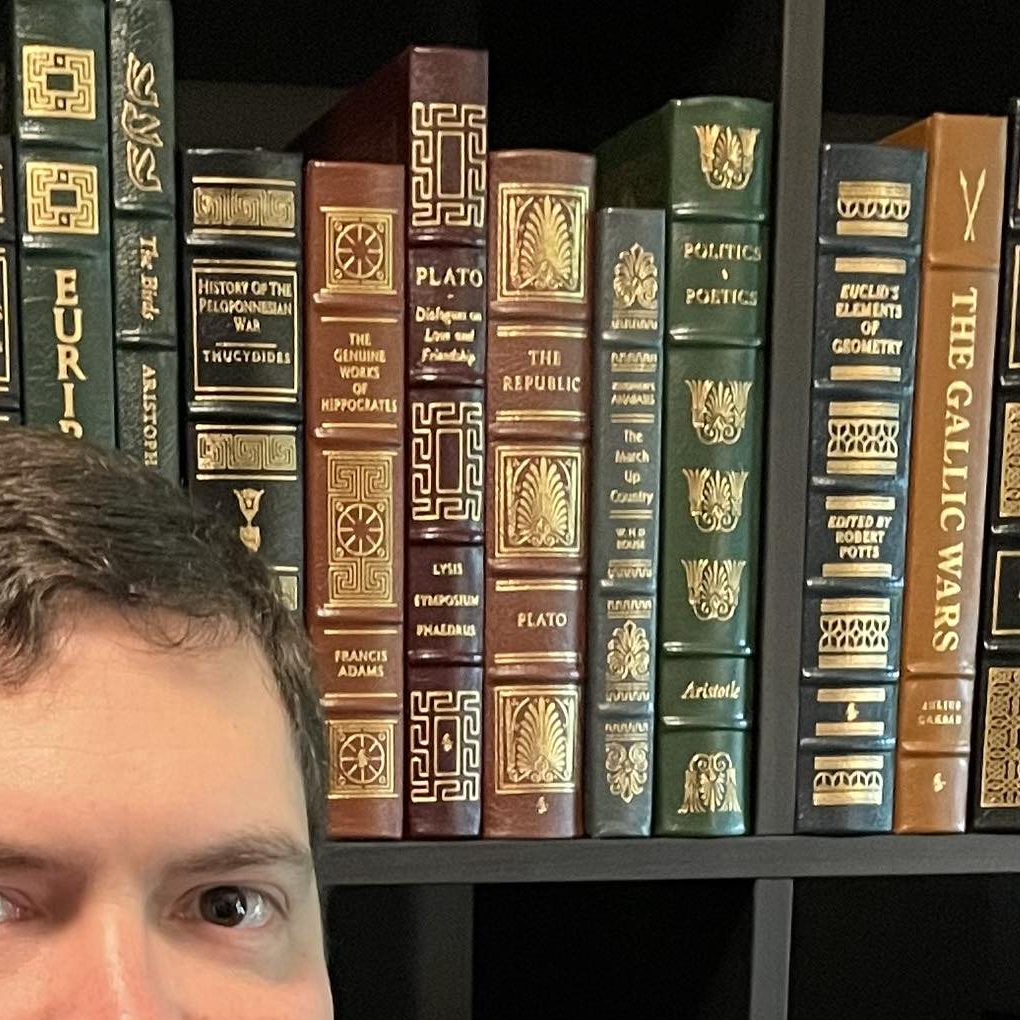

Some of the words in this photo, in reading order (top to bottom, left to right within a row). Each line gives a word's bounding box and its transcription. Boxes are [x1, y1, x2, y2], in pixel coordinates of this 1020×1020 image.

[140, 236, 159, 270] The
[684, 242, 761, 261] POLITICS
[416, 266, 483, 288] PLATO
[198, 278, 249, 295] HISTORY
[251, 281, 268, 296] OF
[268, 281, 293, 298] THE
[141, 273, 160, 320] Birds
[199, 297, 292, 316] PELOPONNESIAN
[835, 302, 902, 319] ELEMENTS
[233, 316, 261, 333] WAR
[860, 320, 880, 336] OF
[948, 286, 978, 370] THE
[349, 333, 371, 346] THE
[832, 338, 903, 355] GEOMETRY
[202, 350, 291, 364] THUCYDIDES
[333, 348, 386, 363] GENUINE
[528, 350, 561, 366] THE
[339, 366, 380, 379] WORKS
[352, 382, 369, 396] OF
[503, 375, 581, 393] REPUBLIC
[321, 399, 398, 413] HIPPOCRATES
[624, 429, 643, 443] The
[615, 450, 650, 463] March
[940, 380, 973, 532] GALLIC
[625, 470, 640, 484] Up
[610, 489, 653, 505] Country
[827, 515, 874, 528] EDITED
[876, 515, 892, 528] BY
[835, 530, 885, 544] ROBERT
[839, 545, 879, 559] POTTS
[433, 563, 463, 575] LYSIS
[414, 594, 479, 607] SYMPOSIUM
[932, 541, 964, 652] WARS
[517, 612, 568, 628] PLATO
[416, 623, 476, 637] PHAEDRUS
[335, 650, 388, 662] FRANCIS
[338, 664, 384, 678] ADAMS
[681, 680, 740, 699] Aristotle
